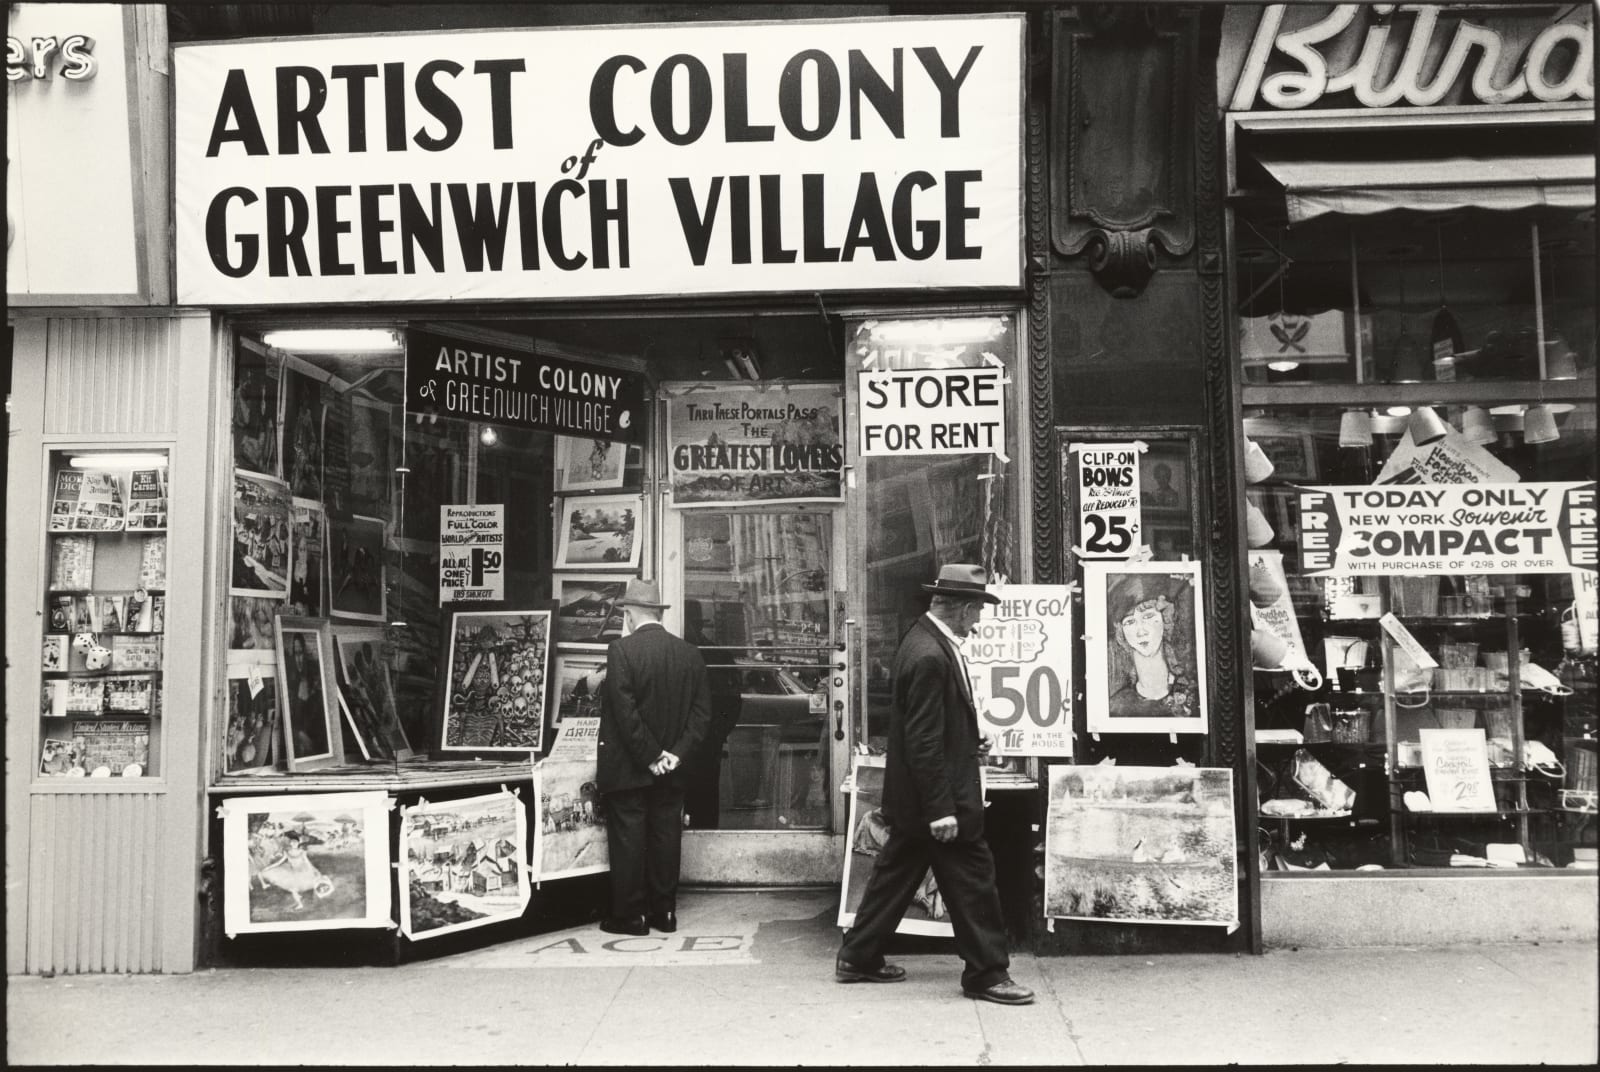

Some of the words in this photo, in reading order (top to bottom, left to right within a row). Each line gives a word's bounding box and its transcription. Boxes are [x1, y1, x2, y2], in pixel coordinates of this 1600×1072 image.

[206, 58, 527, 157] ARTIST
[589, 45, 984, 147] COLONY
[560, 138, 603, 179] of
[205, 177, 630, 278] GREENWICH
[668, 170, 982, 266] VILLAGE
[435, 347, 521, 383] ARTIST
[539, 365, 621, 400] COLONY
[866, 374, 999, 409] STORE
[419, 379, 436, 401] of
[446, 380, 548, 424] GREENWICH
[554, 397, 612, 433] VILLAGE
[740, 422, 768, 437] THE
[865, 424, 923, 451] FOR
[931, 422, 999, 449] RENT
[673, 445, 772, 471] GREATEST
[773, 444, 842, 471] LOVERS
[1082, 452, 1135, 465] CLIP-ON
[718, 474, 745, 491] OF
[749, 474, 787, 492] ART
[1082, 467, 1133, 487] BOWS
[1343, 490, 1446, 508] TODAY
[1462, 489, 1549, 507] ONLY
[447, 521, 470, 529] FULL
[471, 520, 498, 529] COLOR
[1349, 515, 1390, 526] NEW
[1397, 514, 1445, 525] YORK
[1449, 507, 1548, 527] Souvenir
[1568, 490, 1598, 564] FREE
[1300, 492, 1331, 568] FREE
[1349, 528, 1553, 557] COMPACT
[442, 558, 456, 568] ALL
[1347, 562, 1376, 570] WITH
[1382, 561, 1443, 569] PURCHASE
[1449, 561, 1465, 569] OF
[1501, 560, 1517, 568] OR
[1524, 559, 1554, 568] OVER
[441, 578, 465, 587] PRICE
[444, 570, 465, 578] ONE
[1036, 595, 1070, 617] GO!
[971, 625, 1007, 640] NOT
[971, 643, 1006, 658] NOT
[1002, 728, 1024, 748] TIE
[1031, 741, 1065, 749] HOUSE
[1046, 732, 1063, 740] THE
